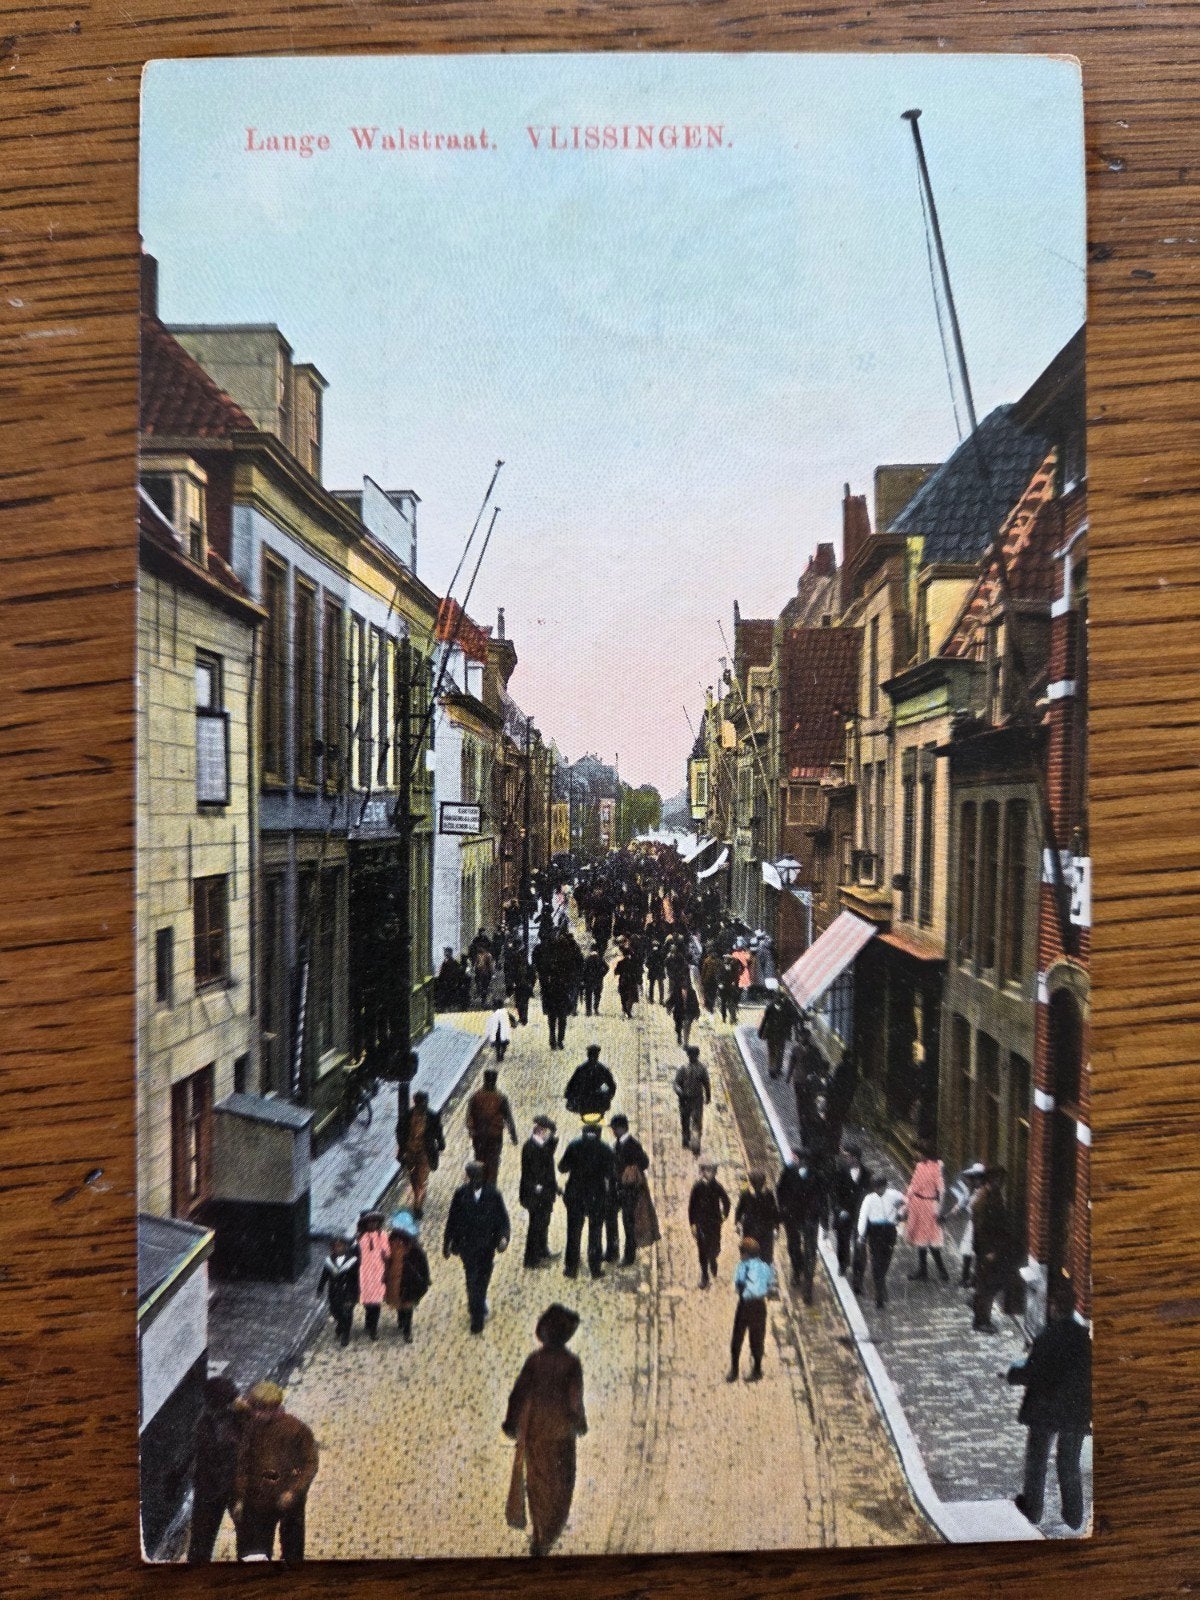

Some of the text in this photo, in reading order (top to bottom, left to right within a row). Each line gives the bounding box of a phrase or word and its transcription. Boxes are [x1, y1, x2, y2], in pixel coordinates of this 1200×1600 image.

[246, 124, 733, 158] Lange Walstraat. VLISSINGEN.
